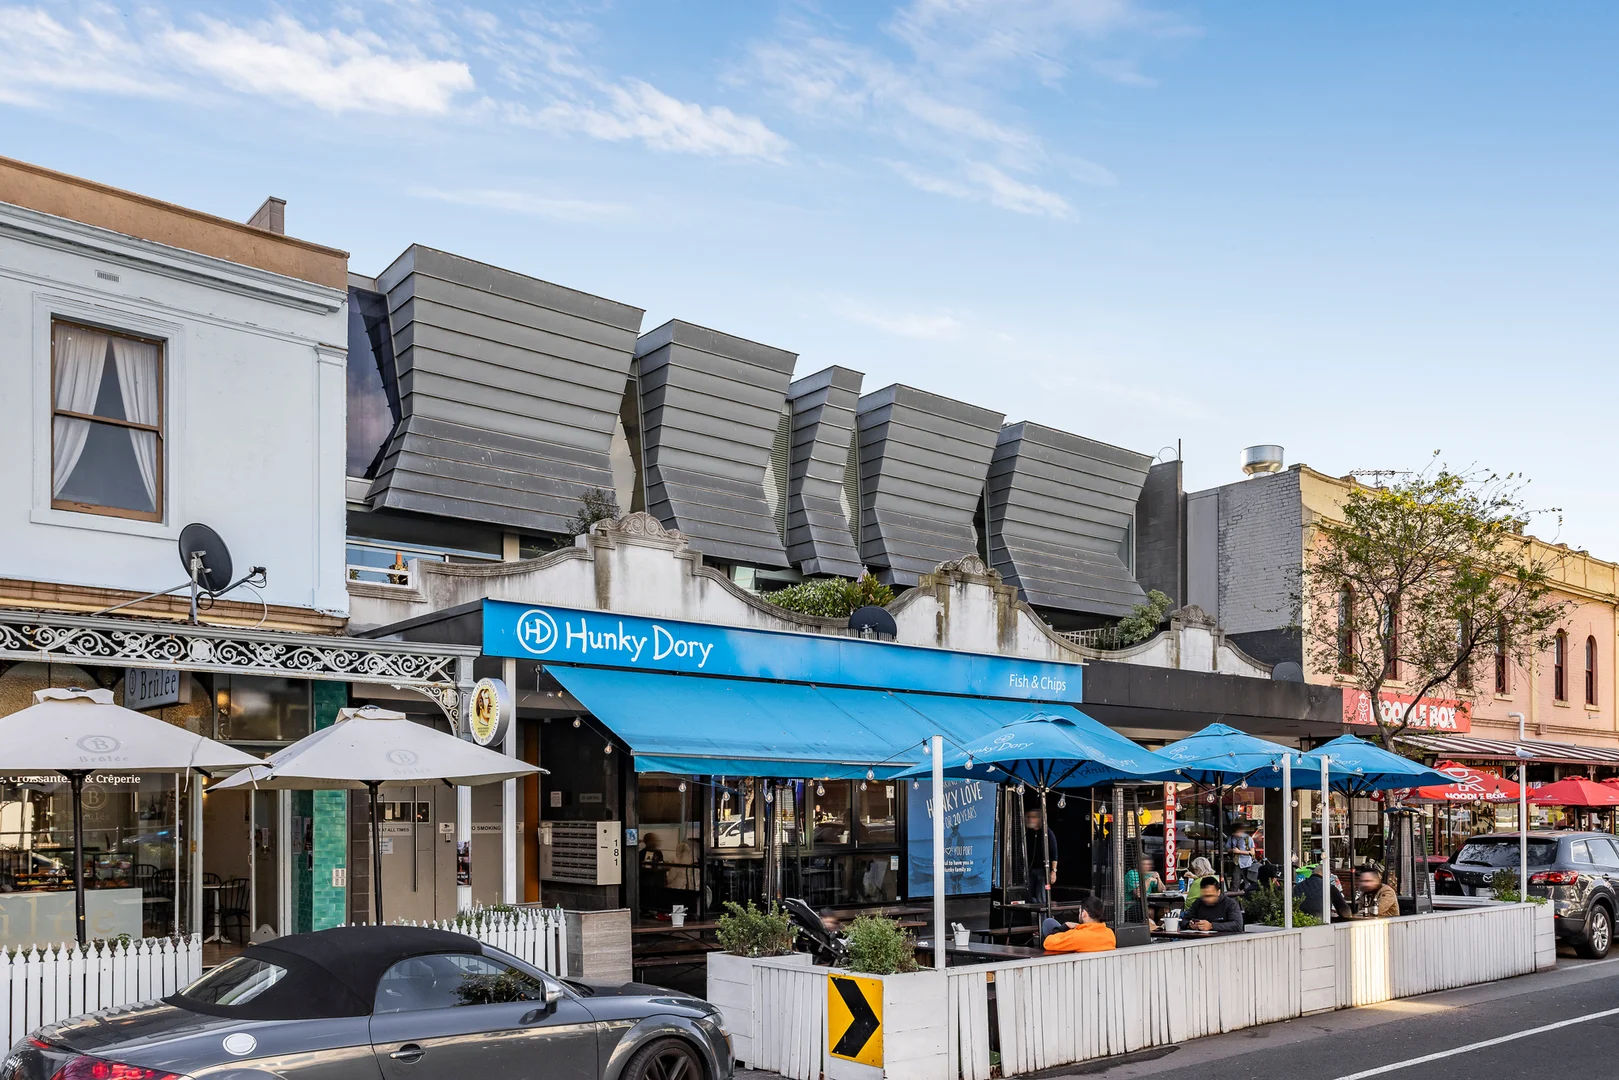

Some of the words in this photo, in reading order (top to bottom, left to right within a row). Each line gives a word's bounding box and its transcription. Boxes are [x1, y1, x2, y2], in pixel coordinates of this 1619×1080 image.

[565, 617, 648, 662] Hunky
[652, 624, 714, 668] Dory
[140, 669, 177, 701] Brûlée
[1009, 673, 1029, 688] Fish
[1031, 674, 1040, 689] &
[1040, 676, 1067, 694] Chips
[1429, 705, 1457, 729] BOX
[997, 742, 1034, 751] Dory
[84, 774, 94, 783] &
[96, 774, 141, 786] Crêperie
[926, 789, 959, 819] HNKY
[960, 781, 984, 806] LOVE
[1166, 781, 1176, 806] BO
[1445, 792, 1485, 800] NOODLE
[953, 813, 961, 826] 20
[960, 805, 977, 823] YEARS
[962, 845, 973, 856] PORT
[1166, 809, 1176, 881] NOODLE
